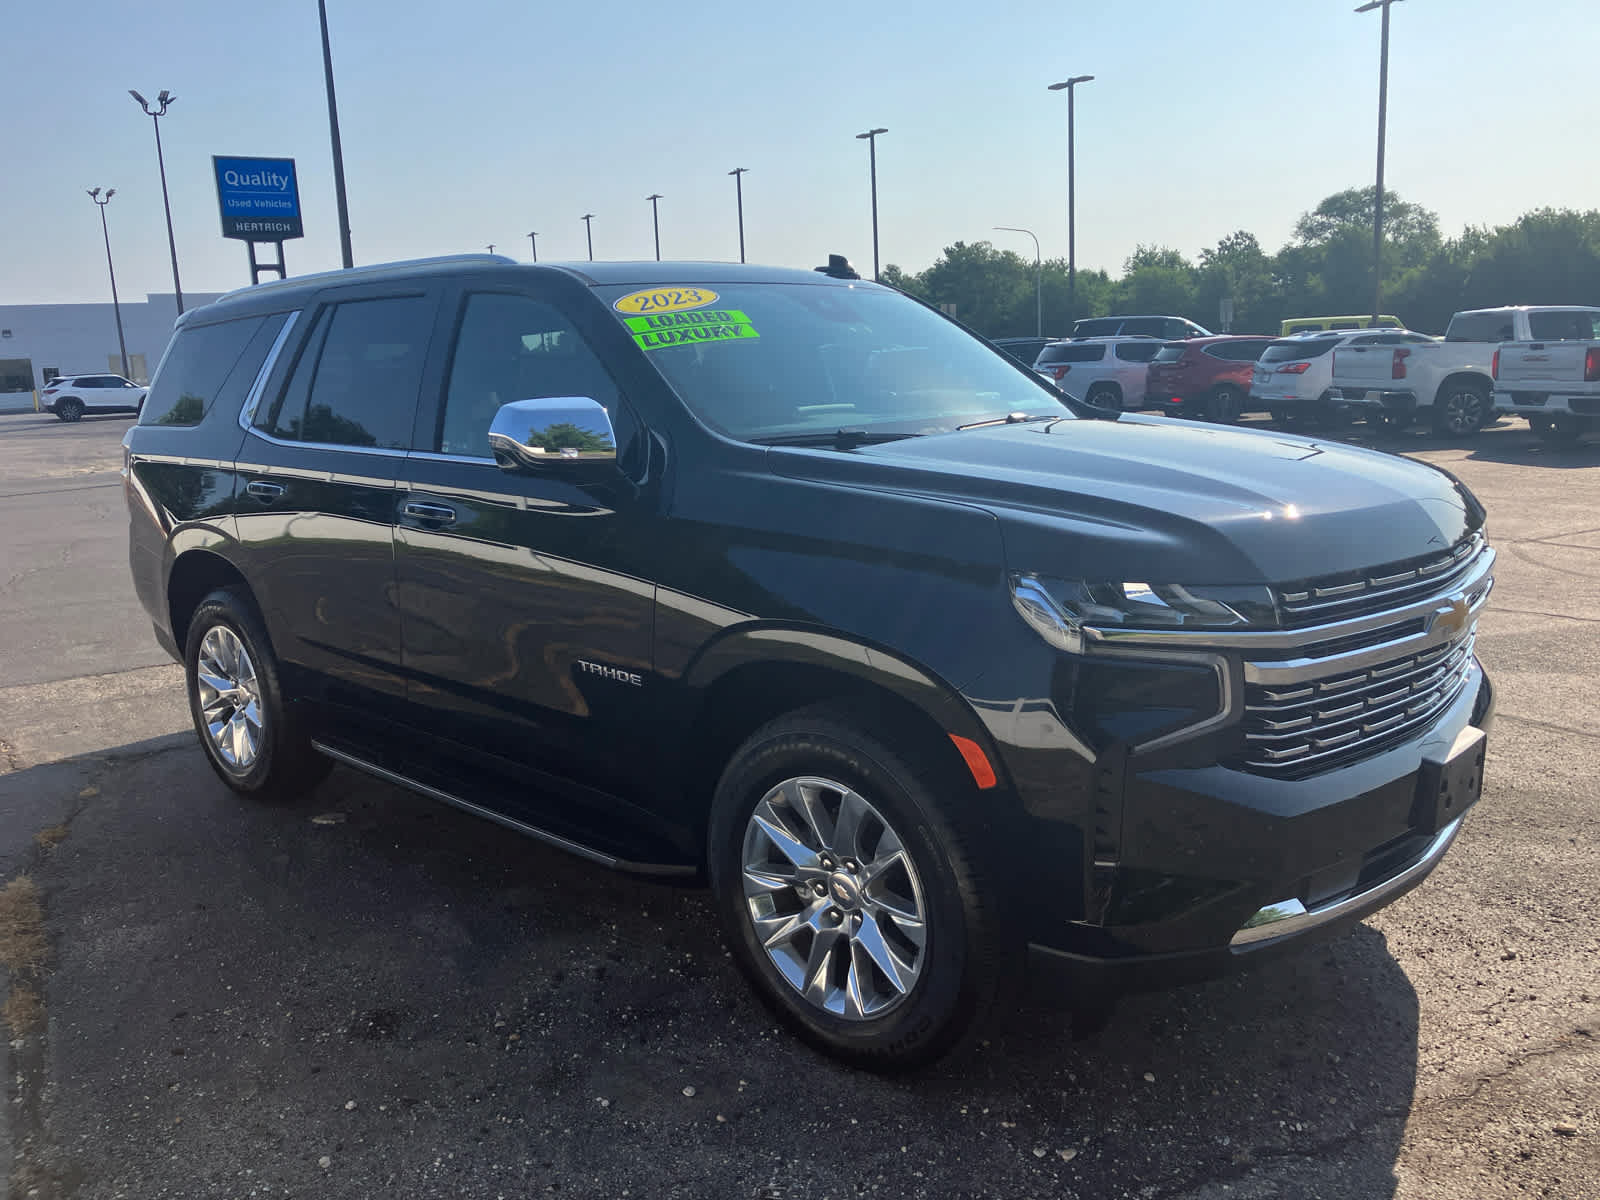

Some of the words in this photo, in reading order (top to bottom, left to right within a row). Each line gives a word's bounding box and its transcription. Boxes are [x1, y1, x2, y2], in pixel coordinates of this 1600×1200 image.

[224, 170, 289, 191] Quality
[227, 199, 252, 208] Used
[254, 199, 292, 208] Vehicles
[236, 222, 291, 232] HERTRICH
[634, 288, 702, 311] 2023
[645, 311, 733, 329] LOADED
[641, 324, 744, 347] LUXURY
[578, 659, 642, 687] TAHOE
